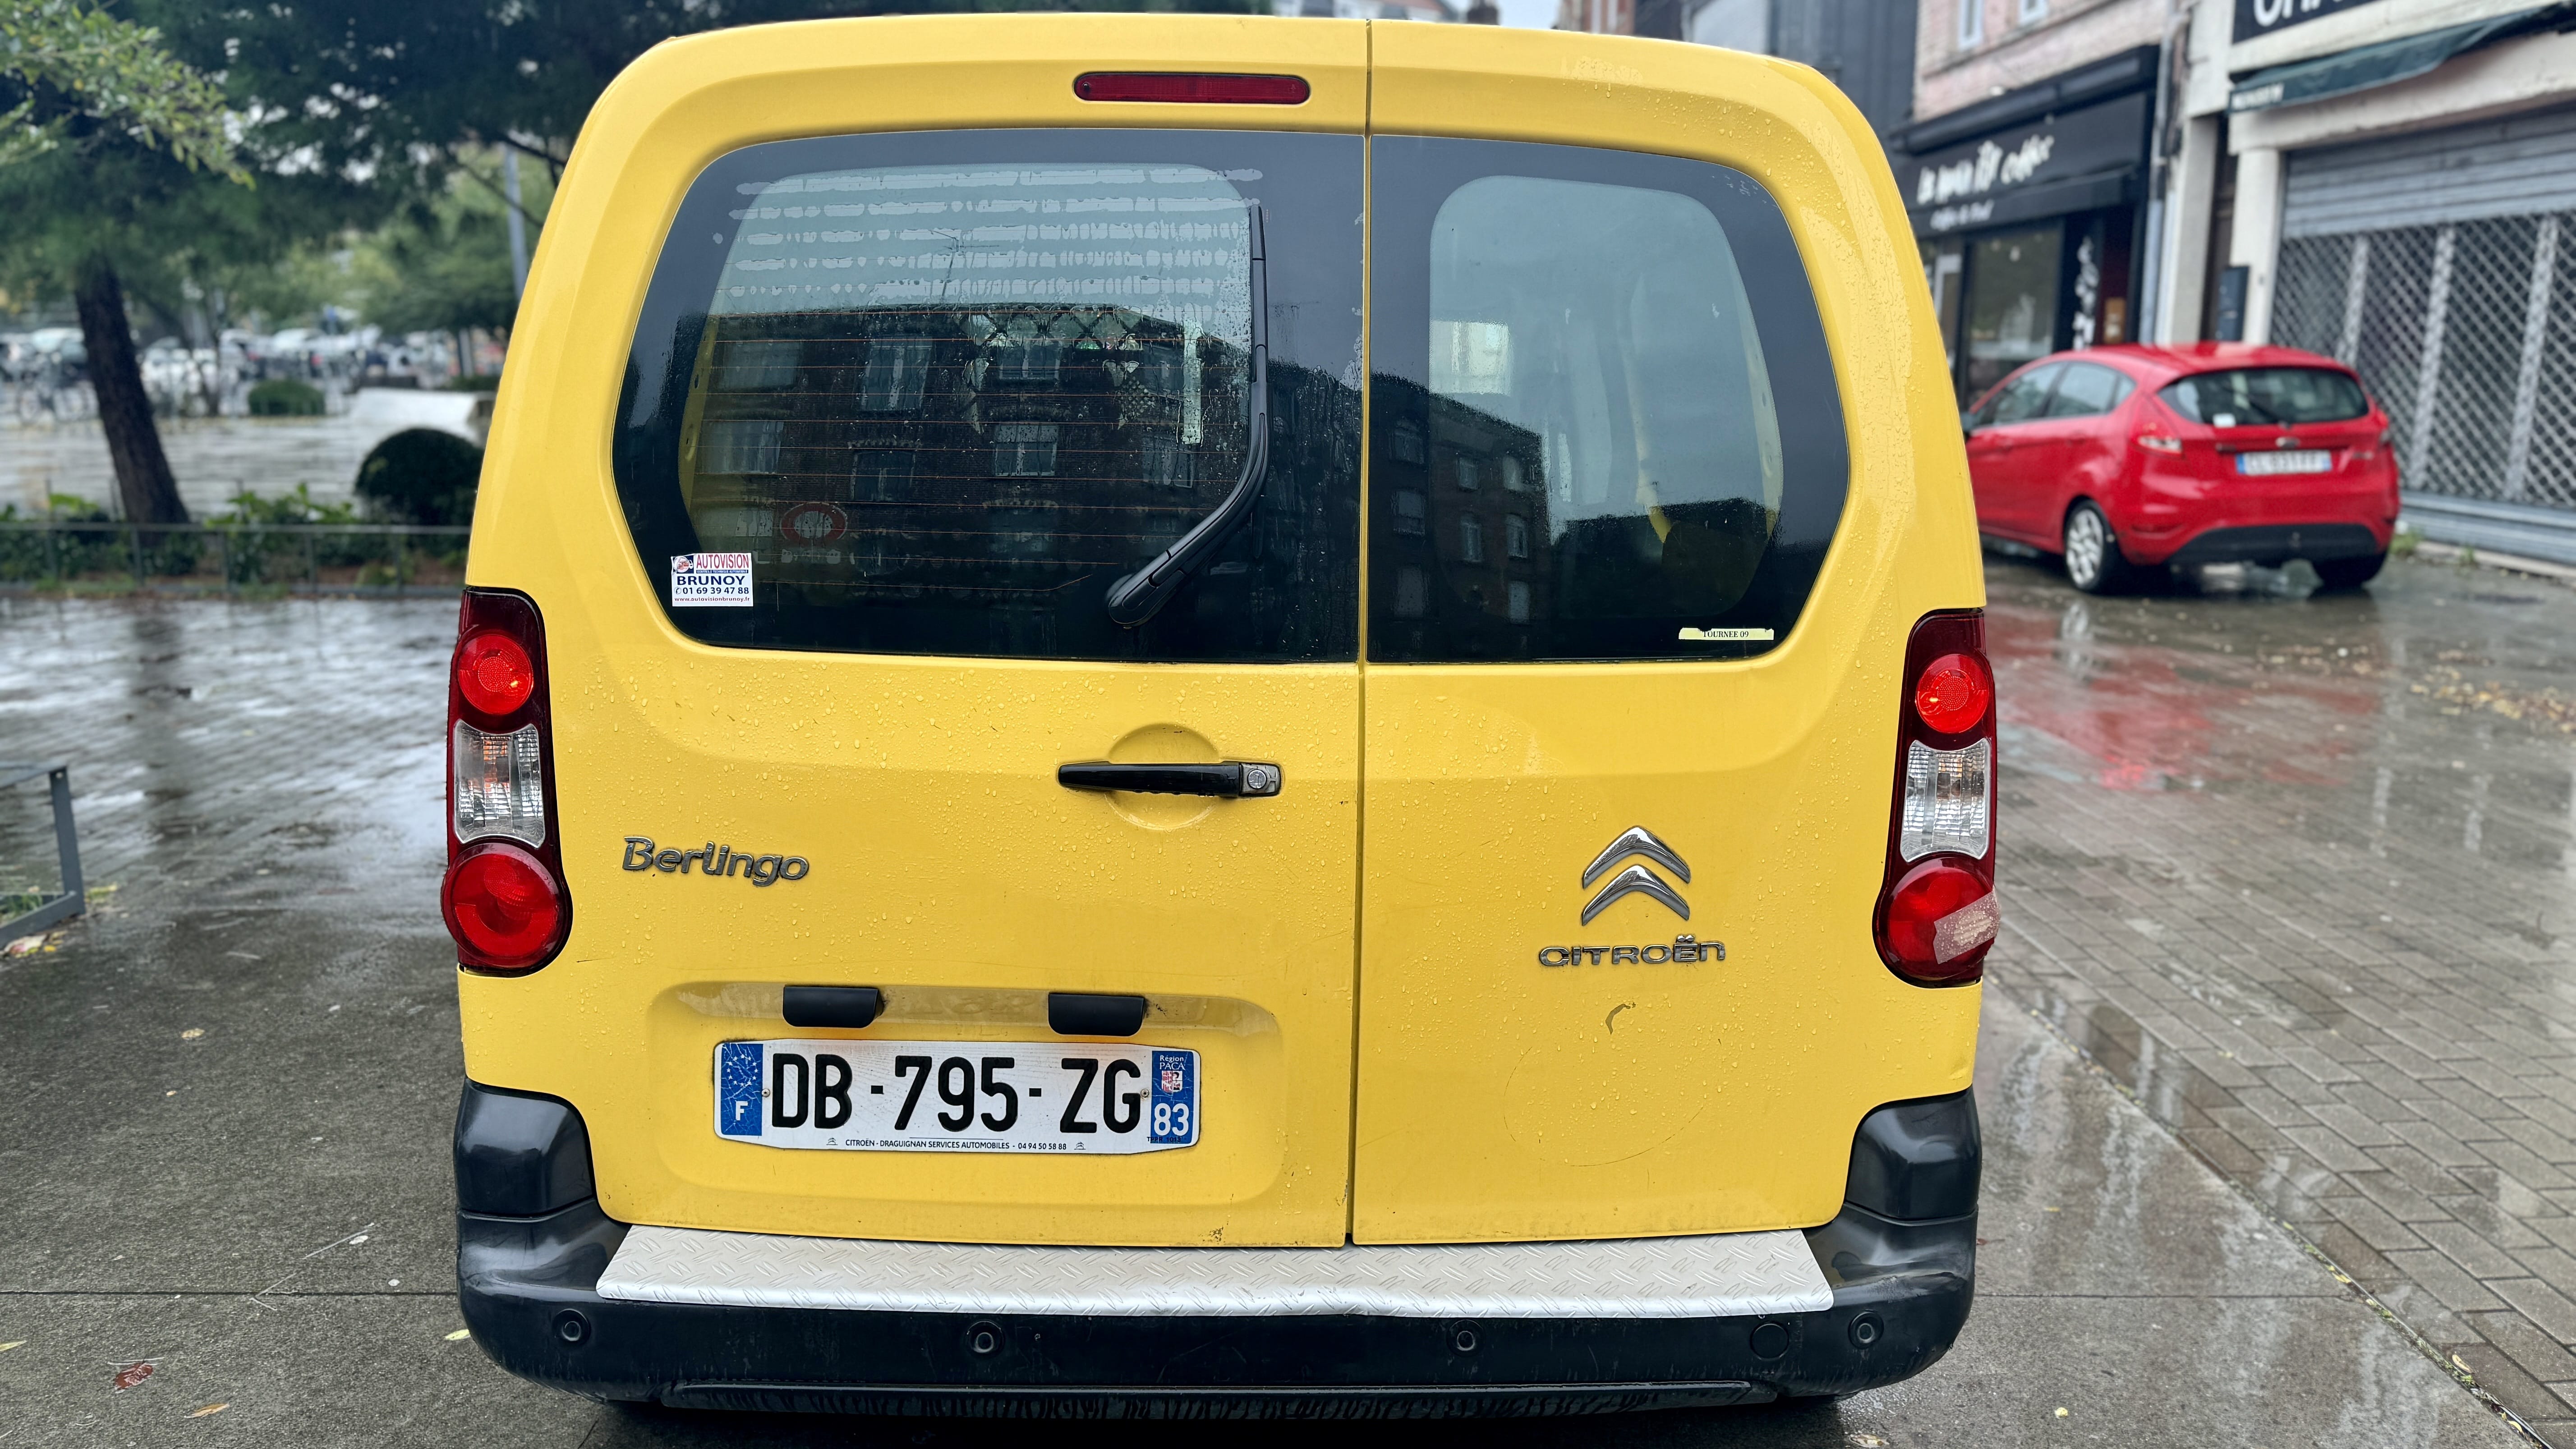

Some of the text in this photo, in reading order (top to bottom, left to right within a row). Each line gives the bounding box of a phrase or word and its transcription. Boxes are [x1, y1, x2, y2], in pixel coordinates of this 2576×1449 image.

[696, 554, 749, 569] AUTOVISION
[677, 576, 745, 585] BRUNOY
[622, 836, 810, 887] Berlingo
[1159, 1062, 1186, 1070] PACA
[735, 1101, 748, 1121] F
[1154, 1103, 1189, 1136] 83
